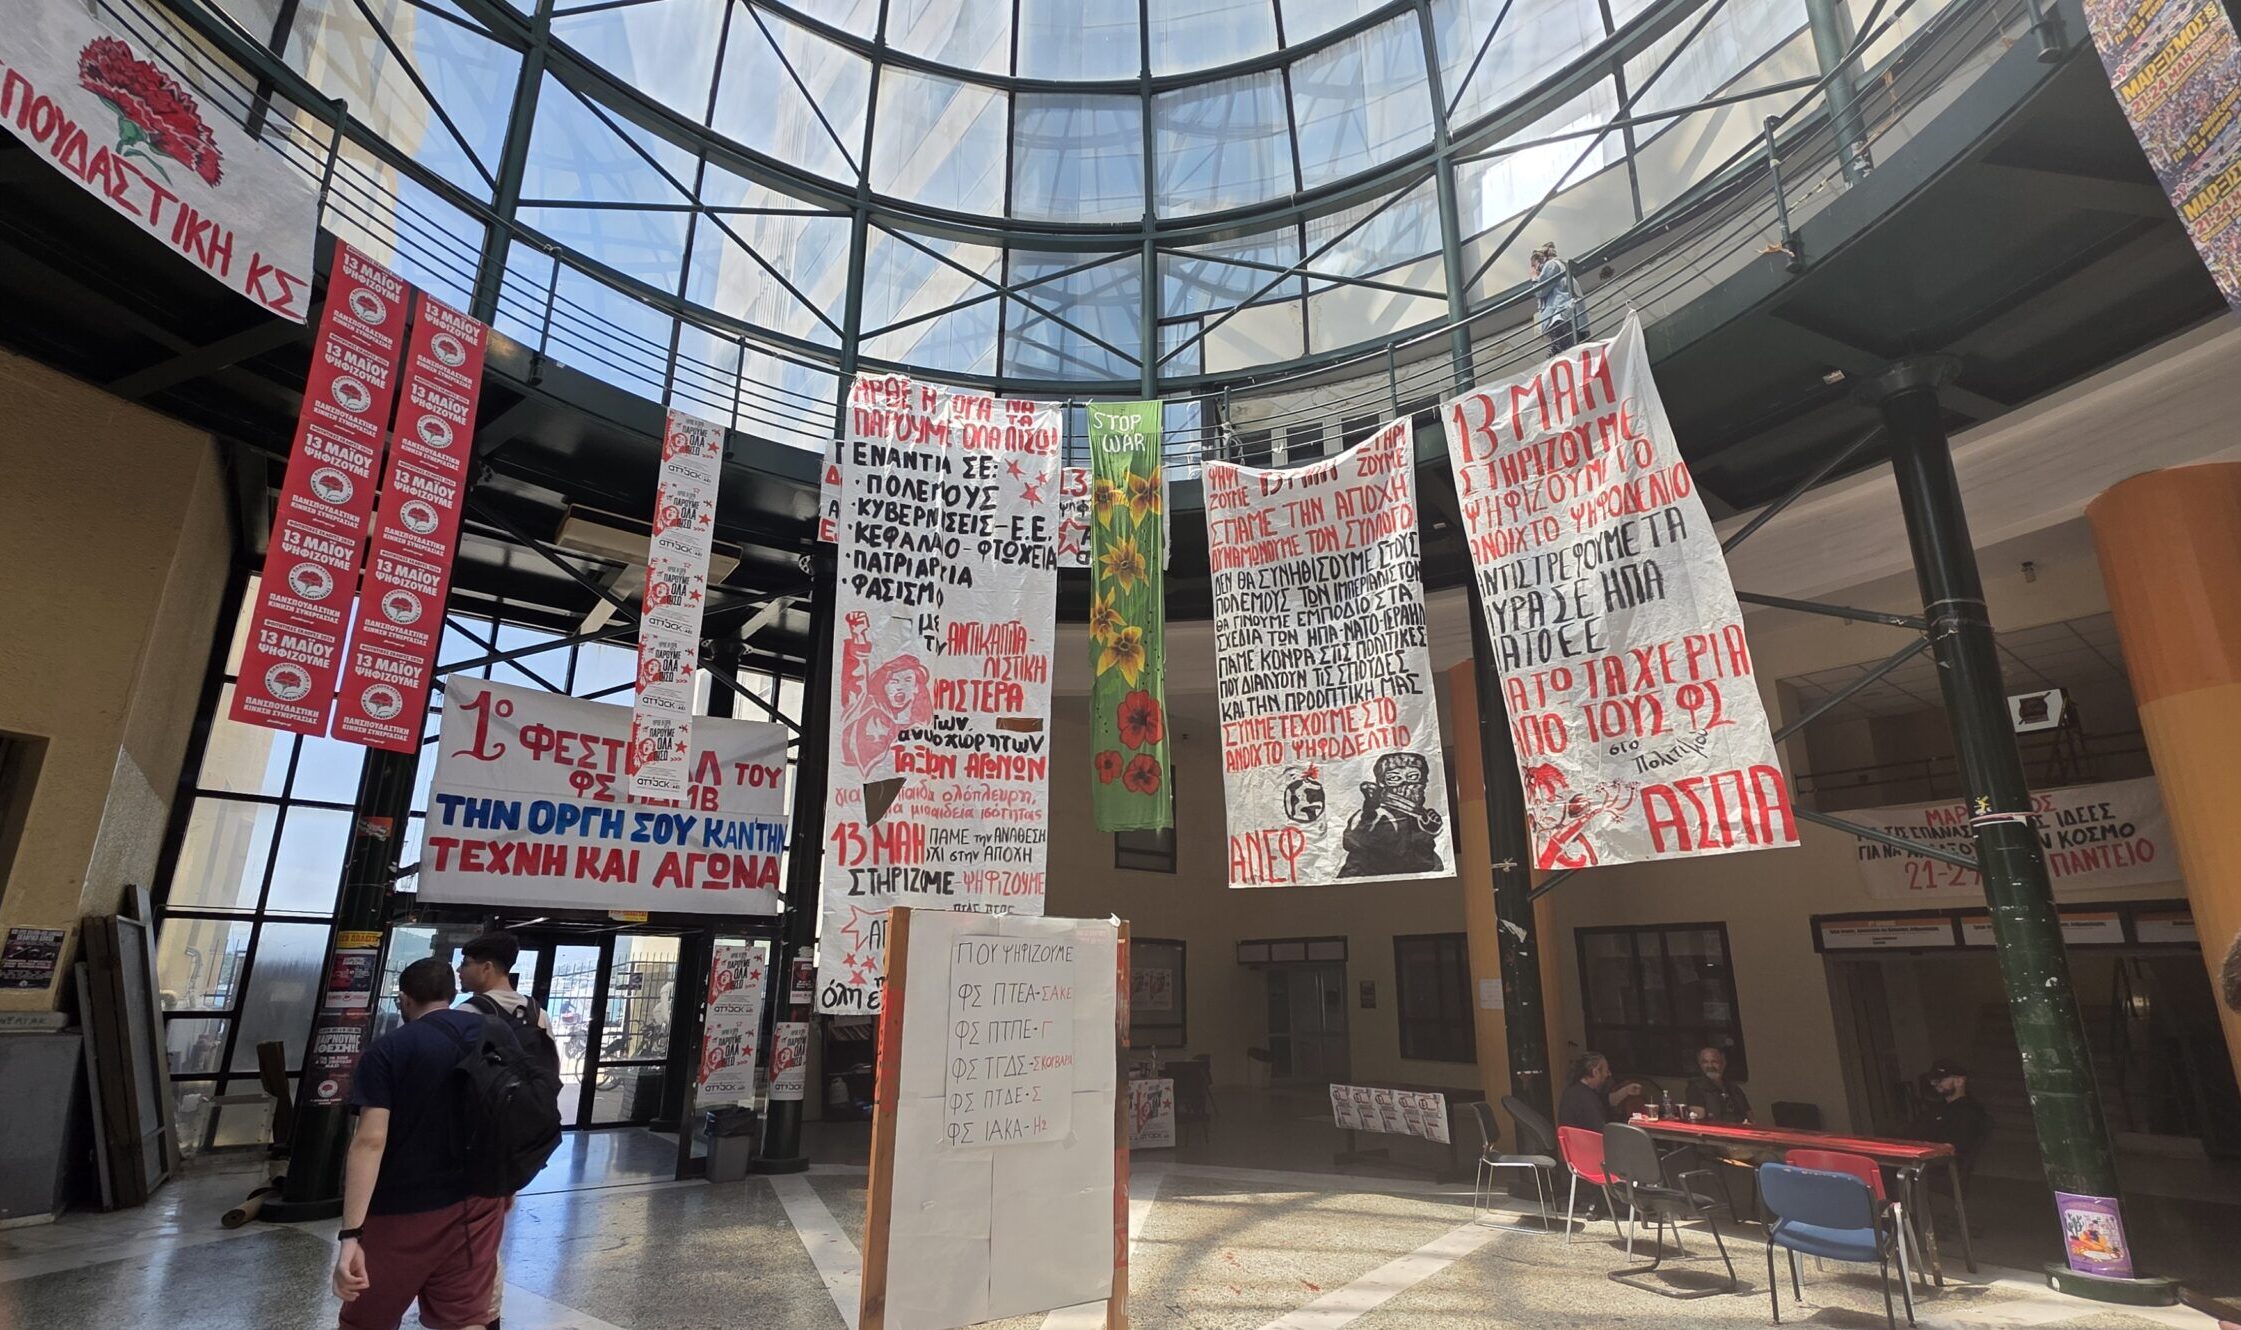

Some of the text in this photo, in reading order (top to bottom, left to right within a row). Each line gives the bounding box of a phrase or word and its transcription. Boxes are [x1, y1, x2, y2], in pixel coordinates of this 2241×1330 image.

[0, 58, 309, 320] ΠΟΥΔΑΣΤΙΚΗ ΚΣ
[342, 265, 400, 304] ΨΗΦΙΖΟΥΜΕ
[344, 253, 403, 292] 13 ΜΑΪΟΥ
[424, 313, 478, 346] ΨΗΦΙΖΟΥΜΕ
[425, 302, 481, 336] 13 ΜΑΪΟΥ
[410, 395, 467, 426] ΨΗΦΙΖΟΥΜΕ
[411, 384, 469, 416] 13 ΜΑΪΟΥ
[1452, 345, 1616, 463] 13 ΜΑΗ
[1093, 413, 1141, 431] STOP
[306, 433, 373, 468] 13 ΜΑΪΟΥ
[853, 442, 951, 474] ΕΝΑΝΤΙΑ
[1102, 433, 1146, 453] WAR
[1459, 396, 1645, 497] ΣΤΗΡΙΖΟΥΜΕ
[304, 445, 370, 478] ΨΗΦΙΖΟΥΜΕ
[1357, 448, 1408, 477] ΖΟΥΜΕ
[867, 474, 999, 511] ΠΟΛΕΜΟΥΣ
[1210, 508, 1277, 548] ΣΠΑΜΕ
[1282, 497, 1325, 528] ΤΗΝ
[1335, 474, 1408, 520] ΑΠΟΧΗ
[1470, 461, 1690, 565] ΑΝΟΙΧΤΟ ΨΗΦΟΔΕΛΤΙΟ
[1641, 506, 1687, 547] ΤΑ
[283, 529, 354, 560] 13 ΜΑΪΟΥ
[855, 521, 960, 559] ΚΕΦΑΛΑΟ
[977, 540, 1057, 571] ΦΤΩΧΕΙΑ
[1211, 503, 1413, 573] ΔΥΝΑΜΩΝΟΥΜΕ ΤΟΝ ΣΥΛΛΟΓΟ
[281, 542, 351, 572] ΨΗΦΙΖΟΥΜΕ
[377, 558, 441, 587] 13 ΜΑΪΟΥ
[1215, 532, 1419, 596] ΔΕΝ ΘΑ ΣΥΝΗΘΙΣΟΥΜΕ ΣΤΟΥΣ
[375, 571, 438, 597] ΨΗΦΙΖΟΥΜΕ
[1216, 561, 1422, 617] ΠΟΛΕΜΟΥΣ ΤΩΝ ΙΜΠΕΡΙΑΛΙΣΤΩΝ
[1551, 559, 1665, 624] ΣΕ ΗΠΑ
[1217, 583, 1413, 632] ΘΑ ΓΙΝΟΥΜΕ ΕΜΠΟΔΙΟ ΣΤΑ
[258, 642, 331, 669] ΨΗΦΙΖΟΥΜΕ
[260, 629, 334, 658] 13 ΜΑΪΟΥ
[1217, 628, 1298, 652] ΣΧΕΔΙΑ ΤΩΝ
[1218, 650, 1254, 678] ΠΑΜΕ
[1319, 641, 1352, 665] ΣΤΙΣ
[1355, 626, 1427, 660] ΠΟΛΙΤΙΚΕΣ
[355, 666, 420, 689] ΨΗΦΙΖΟΥΜΕ
[356, 653, 422, 679] 13 ΜΑΪΟΥ
[984, 655, 1047, 684] ΛΙΣΤΙΚΗ
[1220, 650, 1409, 698] ΠΟΥ ΔΙΑΛΥΟΥΝ ΤΙΣ ΣΠΟΥΔΕΣ
[1579, 624, 1750, 698] ΤΑ ΧΕΡΙΑ
[1221, 673, 1423, 722] ΚΑΙ ΤΗΝ ΠΡΟΟΠΤΙΚΗ ΜΑΣ
[1578, 679, 1736, 743] ΤΟΥΣ ΦΣ
[1222, 696, 1397, 747] ΣΥΜΜΕΤΕΧΟΥΜΕ ΣΤΟ
[520, 723, 782, 789] ΦΕΣΤΙΛ ΤΟΥ
[1226, 725, 1411, 773] ΑΝΟΙΧΤΟ ΨΗΦΟΔΕΛΤΙΟ
[964, 752, 1046, 782] ΑΓΩΝΩΝ
[569, 770, 616, 802] ΦΣ
[436, 793, 521, 830] ΤΗΝ
[528, 801, 624, 839] ΟΡΓΗ
[630, 812, 697, 845] ΣΟΥ
[1640, 764, 1799, 853] ΑΣΠΑ
[2056, 803, 2116, 827] ΙΔΕΕΣ
[830, 821, 1046, 867] 13 ΜΑΗ ΠΑΜΕ την ΑΝΑΘΕΣΗ
[2057, 823, 2135, 849] ΚΟΣΜΟ
[429, 837, 780, 890] ΤΕΧΝΗ ΚΑΙ ΑΓΩΝΑ
[950, 846, 1032, 864] στην ΑΠΟΧΗ
[1230, 825, 1305, 884] ΑΝΕΦ
[2050, 838, 2154, 877] ΠΑΝΤΕΙΟ
[958, 942, 1074, 965] ΠΟΥ ΨΗΦΙΖΟΥΜΕ
[958, 983, 982, 1010] ΦΣ
[955, 1020, 980, 1050] ΦΣ
[952, 1057, 978, 1084] ΦΣ
[950, 1090, 974, 1115] ΦΣ
[947, 1122, 974, 1147] ΦΣ
